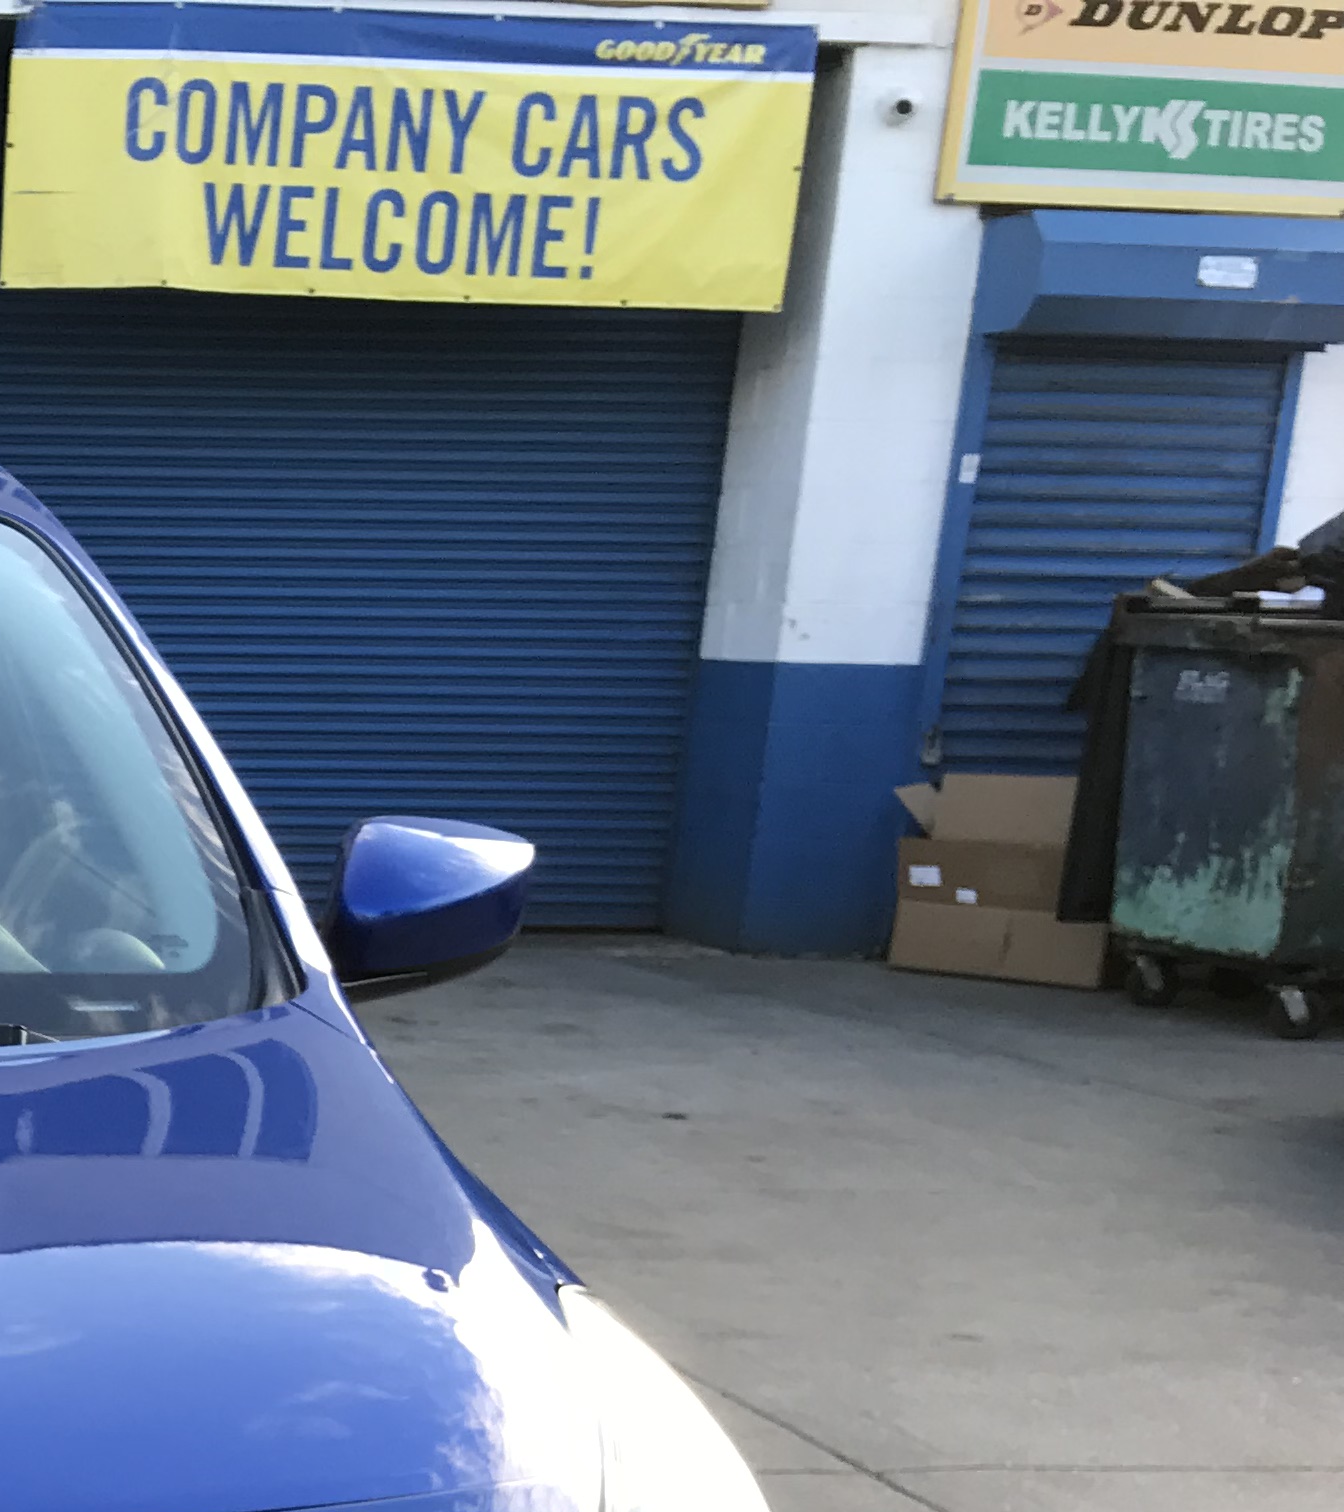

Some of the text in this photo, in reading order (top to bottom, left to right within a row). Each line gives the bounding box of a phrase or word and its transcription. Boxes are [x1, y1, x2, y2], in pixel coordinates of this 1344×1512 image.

[1068, 0, 1344, 39] DUNLOP
[594, 33, 767, 66] GOODYEAR
[124, 76, 706, 183] COMPANY CARS
[1002, 99, 1141, 143] KELLY
[1201, 108, 1326, 153] TIRES
[203, 182, 601, 279] WELCOME!
